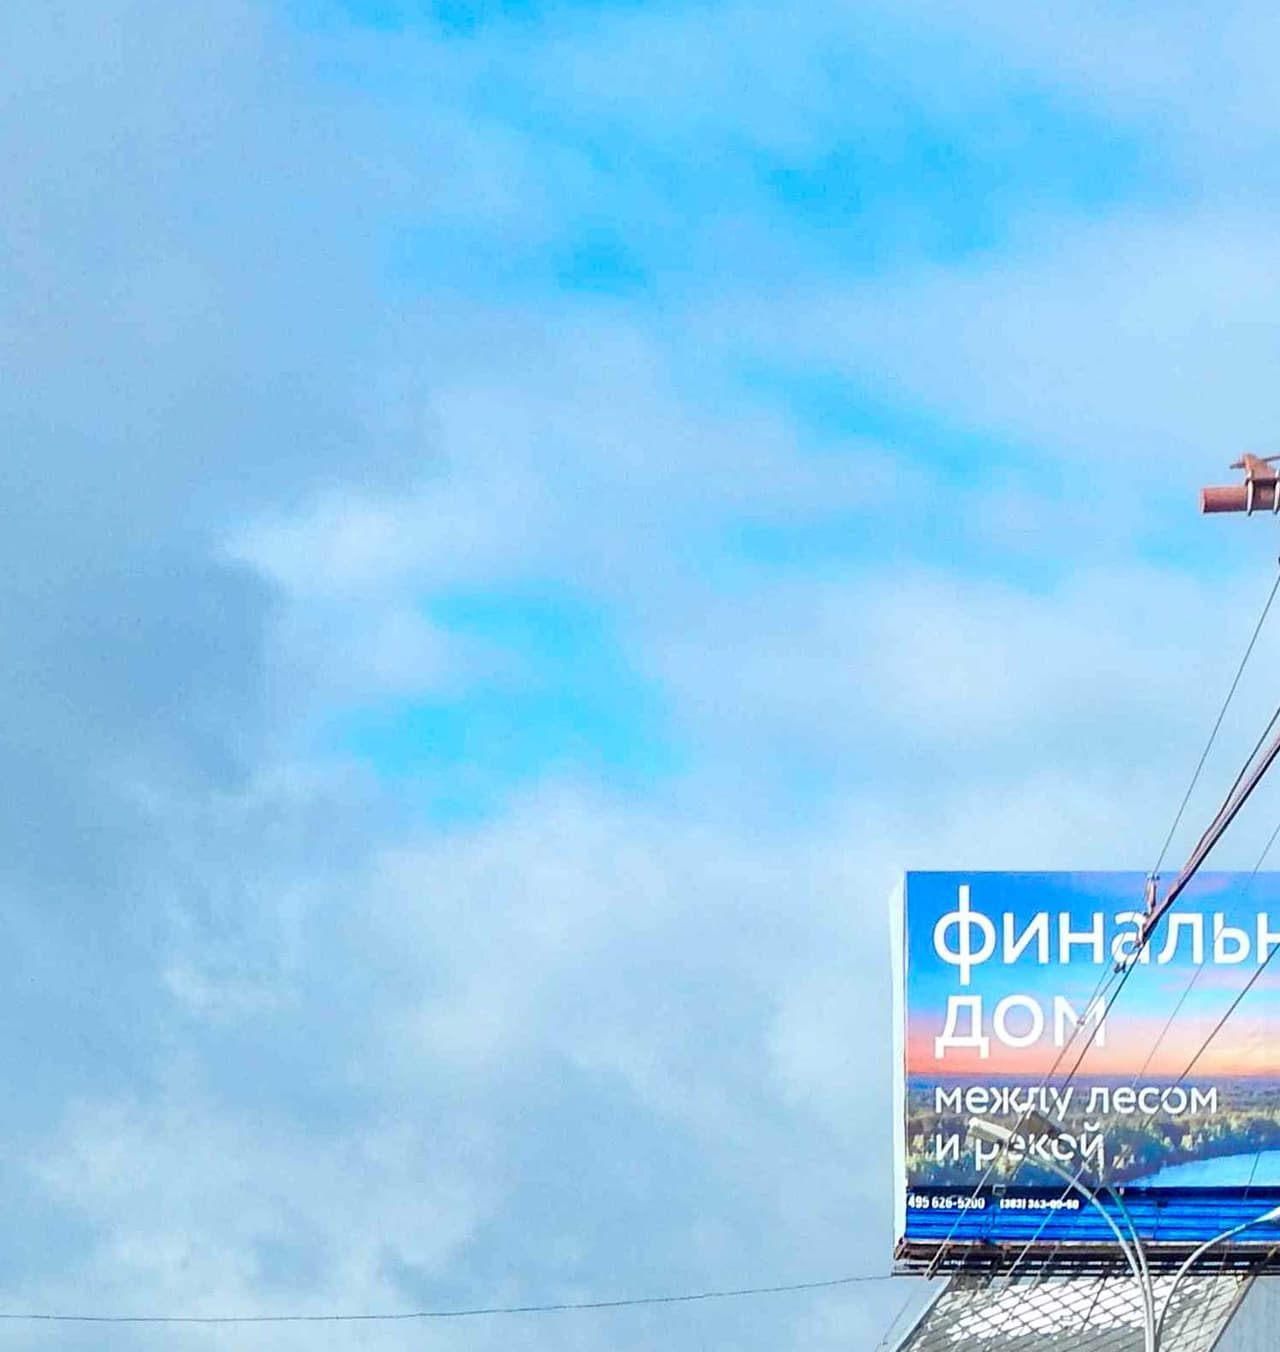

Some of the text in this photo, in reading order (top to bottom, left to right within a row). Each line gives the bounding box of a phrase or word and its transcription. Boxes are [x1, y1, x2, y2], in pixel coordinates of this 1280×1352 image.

[934, 994, 1107, 1059] дом
[935, 1086, 1218, 1122] между лесом
[936, 1133, 960, 1161] и
